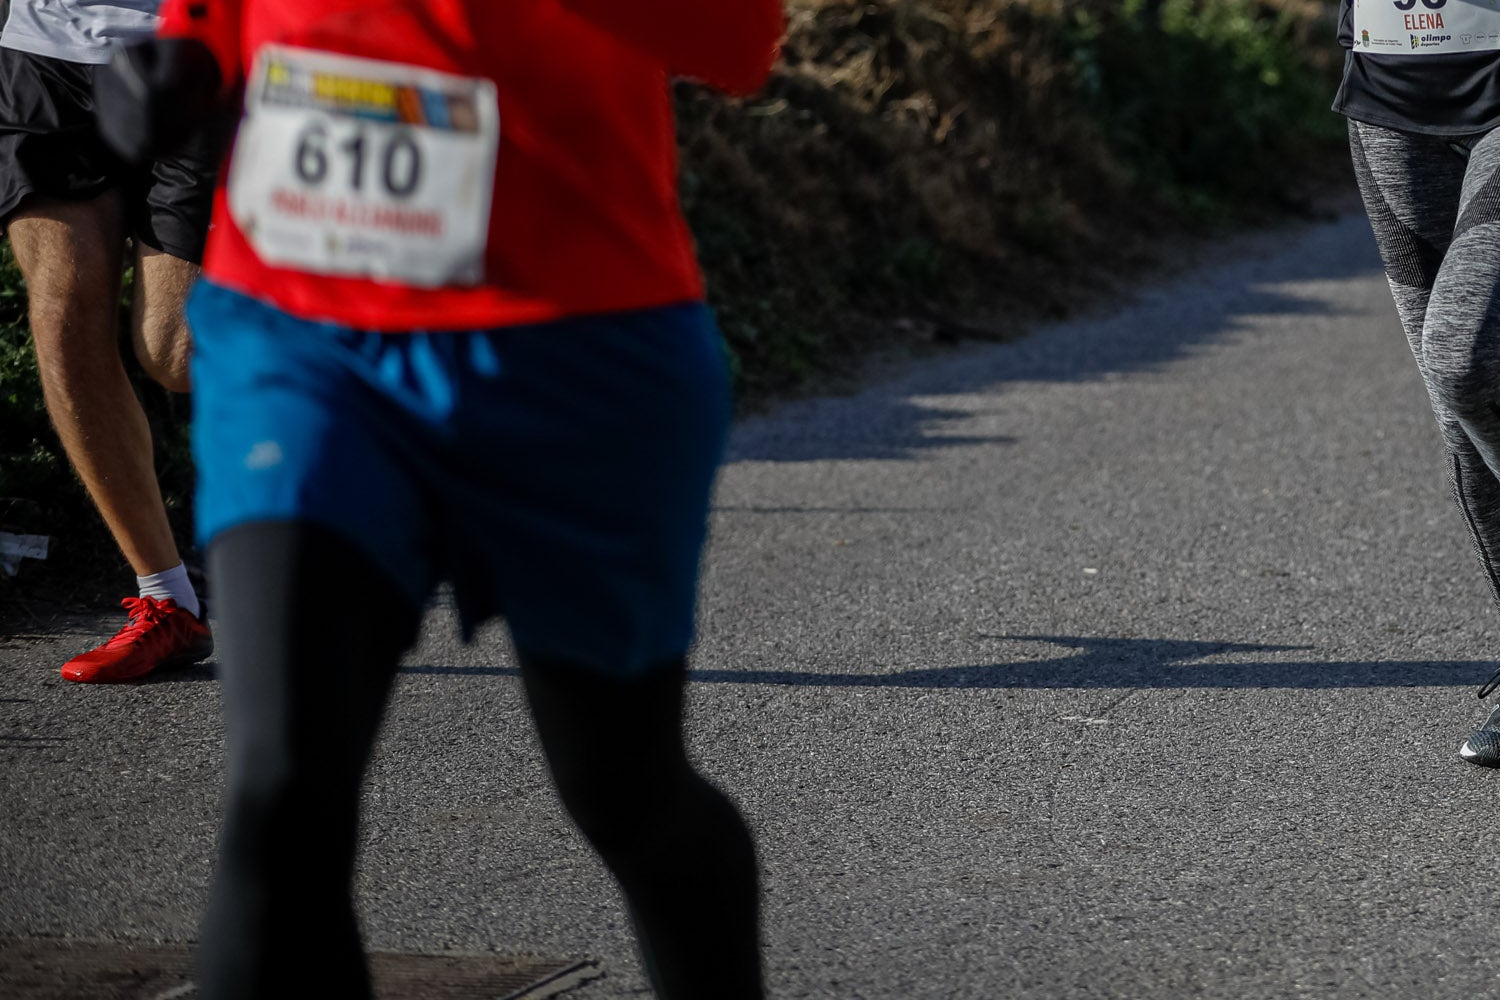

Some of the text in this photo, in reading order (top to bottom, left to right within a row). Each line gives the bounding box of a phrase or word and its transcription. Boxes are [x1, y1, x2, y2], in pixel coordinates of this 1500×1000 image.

[1404, 12, 1445, 30] ELENA
[1420, 34, 1452, 43] olimpo
[295, 122, 422, 198] 610
